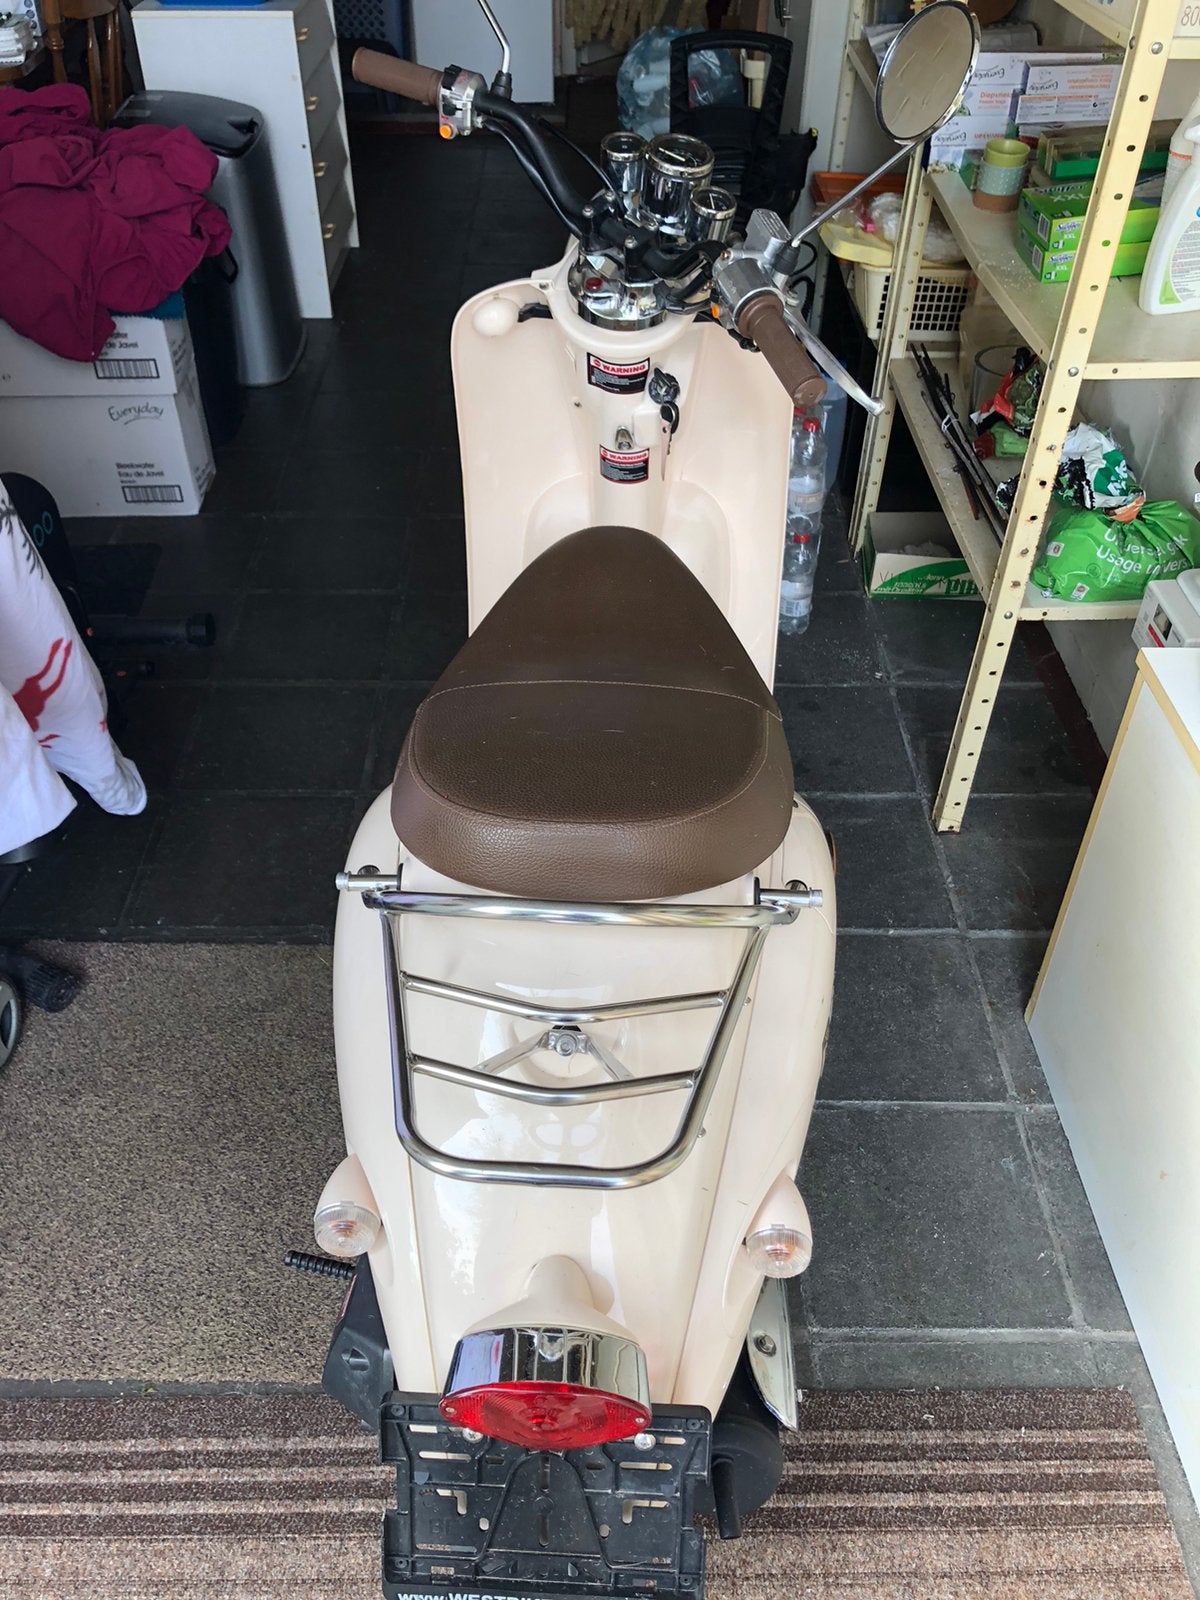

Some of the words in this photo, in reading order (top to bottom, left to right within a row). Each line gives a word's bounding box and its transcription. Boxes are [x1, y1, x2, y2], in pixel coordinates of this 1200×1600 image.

[1181, 5, 1200, 26] 80
[602, 364, 646, 374] WARNING
[108, 402, 164, 422] Everyday
[609, 452, 647, 461] WARNING
[1096, 545, 1142, 573] Usage
